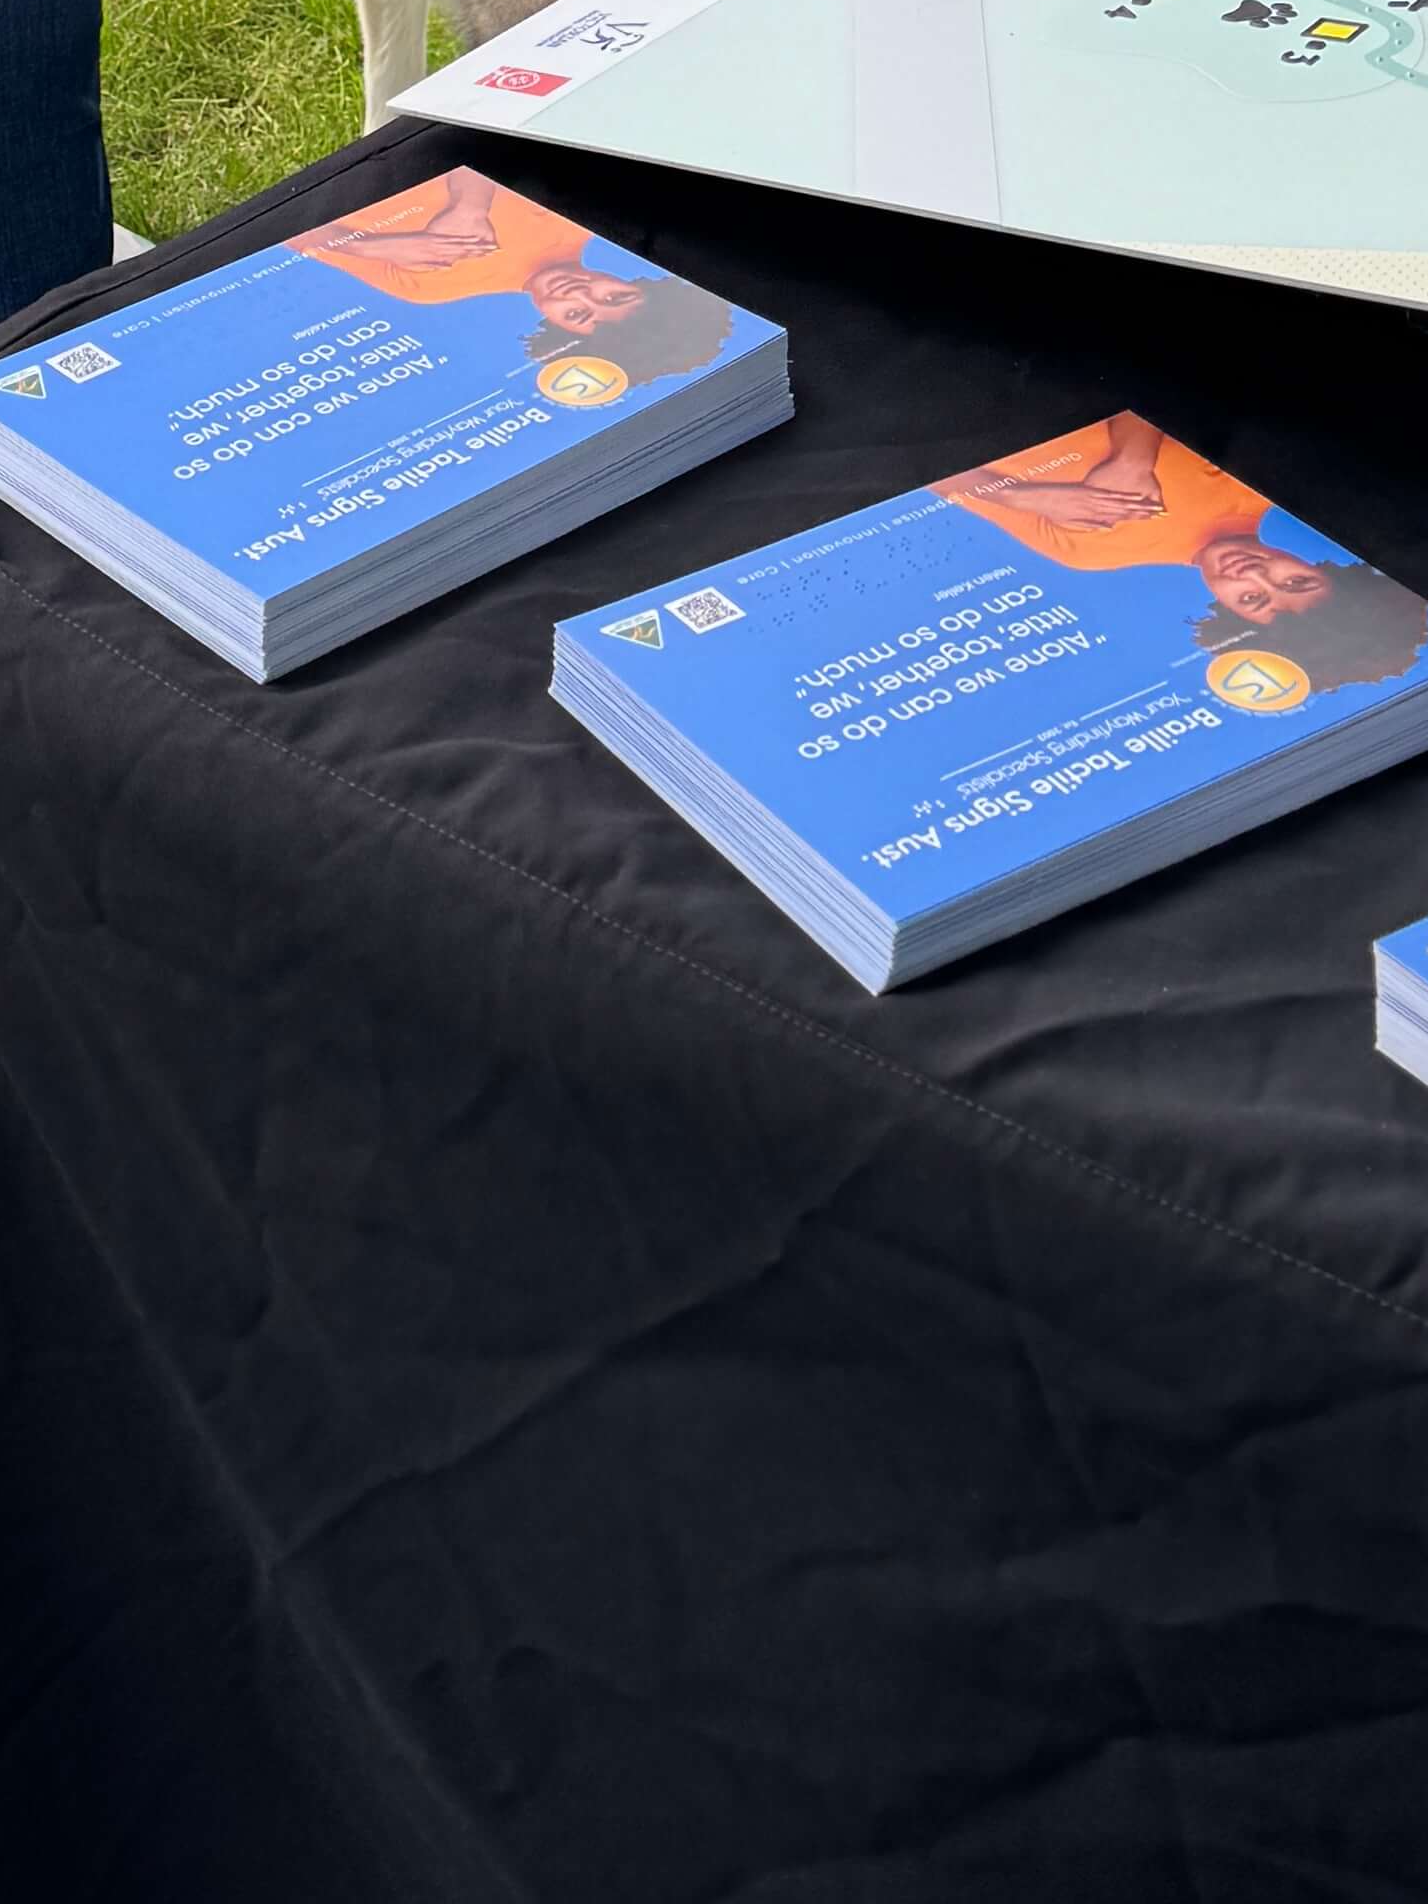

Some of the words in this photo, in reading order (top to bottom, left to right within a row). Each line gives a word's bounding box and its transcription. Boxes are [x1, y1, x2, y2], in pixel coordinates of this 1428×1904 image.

[1102, 4, 1137, 20] 4
[1279, 49, 1320, 67] 3
[334, 319, 391, 347] can
[296, 343, 336, 365] do
[349, 334, 422, 369] little;
[260, 361, 296, 382] so
[224, 364, 356, 424] together,
[312, 391, 359, 415] we
[181, 421, 229, 446] we
[252, 411, 312, 441] can
[464, 406, 552, 450] Braille
[211, 438, 253, 461] do
[172, 457, 211, 480] so
[381, 448, 472, 490] Tactile
[971, 474, 1019, 496] Unity
[305, 487, 385, 527] Signs
[232, 522, 305, 561] Aust.
[790, 526, 879, 564] Innovation
[735, 565, 778, 585] Care
[980, 584, 1043, 614] can
[938, 607, 982, 632] do
[996, 604, 1078, 641] little;
[896, 625, 937, 649] so
[856, 634, 1002, 697] together,
[954, 667, 1005, 693] we
[808, 691, 862, 719] we
[887, 687, 953, 721] can
[841, 714, 887, 740] do
[1045, 710, 1149, 757] Wayfinding
[1122, 706, 1222, 753] Braille
[796, 733, 840, 759] so
[1028, 749, 1131, 795] Tactile
[942, 789, 1033, 833] Signs
[860, 824, 941, 868] Aust.
